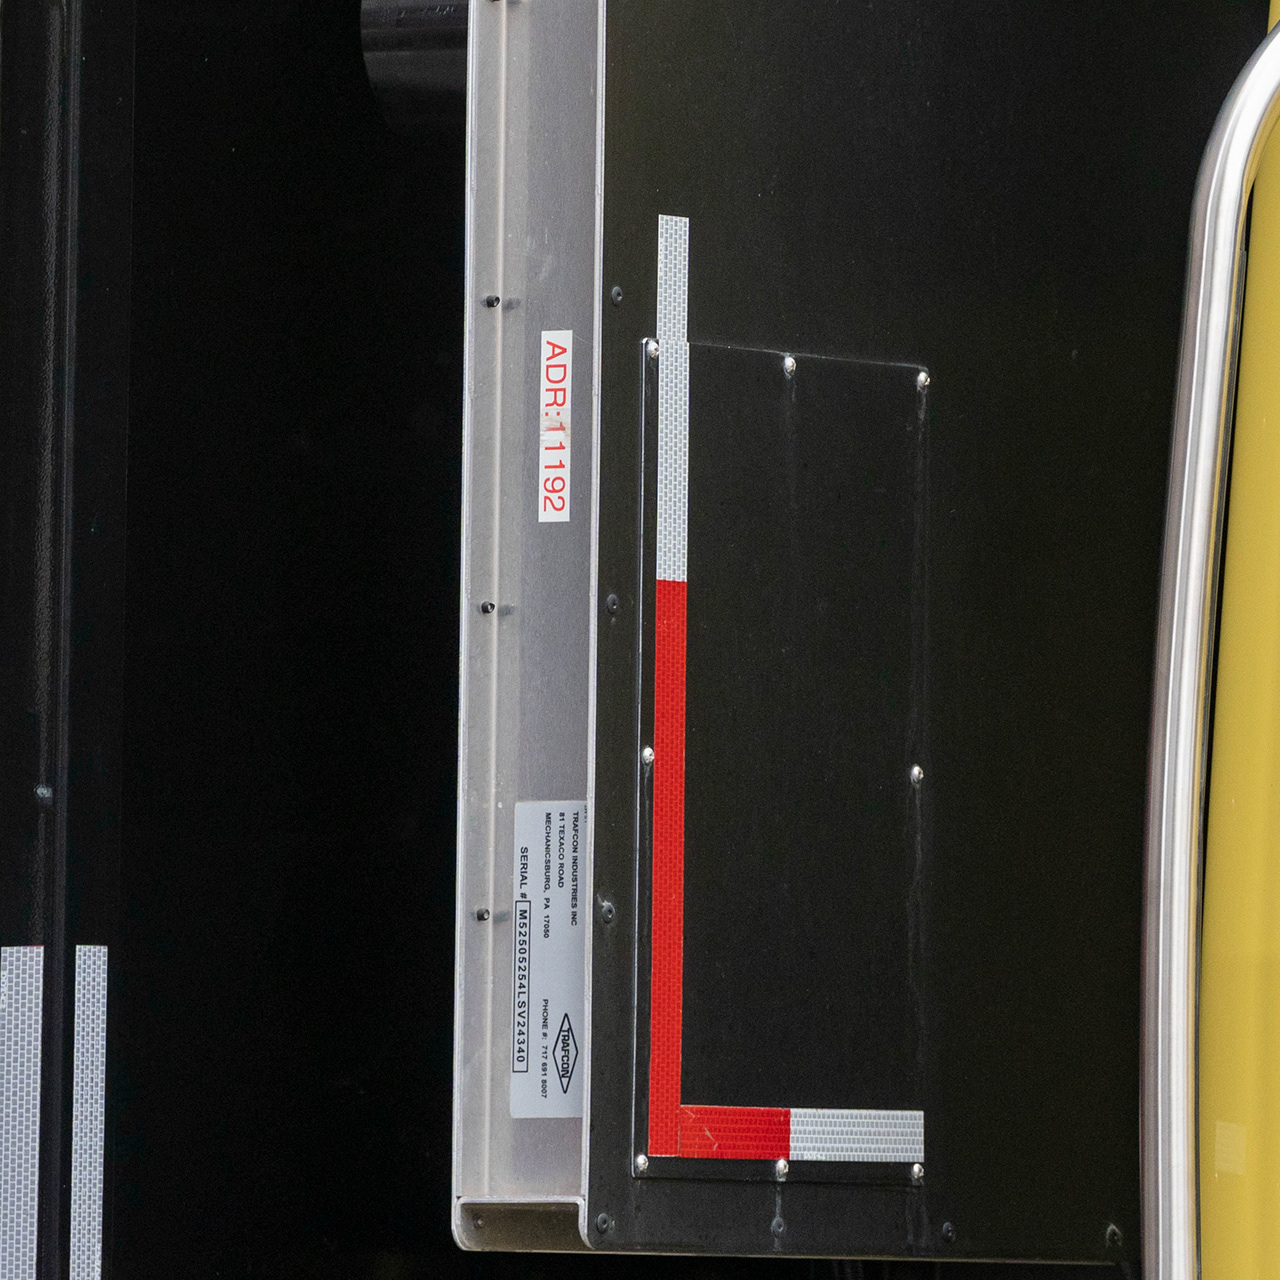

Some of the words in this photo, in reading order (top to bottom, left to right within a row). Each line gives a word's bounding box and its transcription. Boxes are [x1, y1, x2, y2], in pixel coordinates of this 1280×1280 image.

[543, 340, 567, 513] ADR:11192
[558, 812, 566, 822] 81
[520, 846, 528, 889] SERIAL
[543, 812, 552, 893] MECHANICSBURG,
[520, 892, 527, 900] #
[544, 898, 550, 910] PA
[570, 856, 578, 909] INDUSTRIES
[570, 910, 578, 926] INC
[516, 909, 527, 1063] M52505254LSV24340
[560, 1028, 570, 1078] TRAFCON
